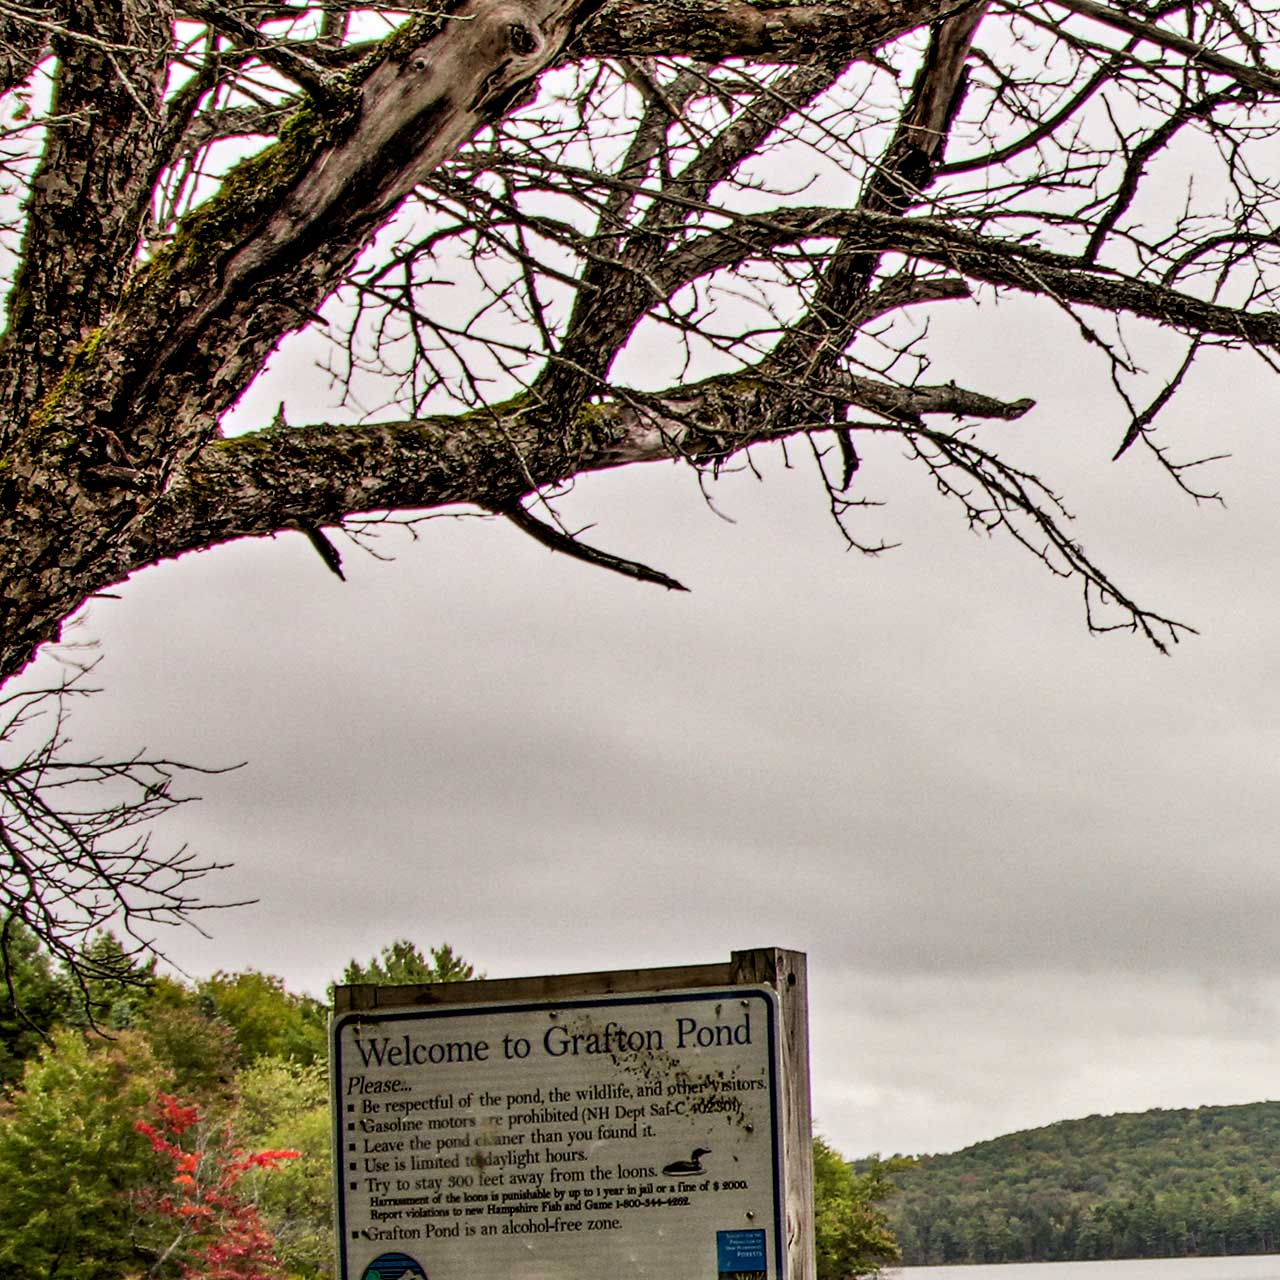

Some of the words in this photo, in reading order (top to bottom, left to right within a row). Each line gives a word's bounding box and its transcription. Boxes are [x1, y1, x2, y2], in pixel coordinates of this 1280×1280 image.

[354, 1035, 489, 1068] Welcome
[502, 1033, 531, 1060] to
[543, 1022, 664, 1057] Grafton
[675, 1013, 753, 1049] Pond
[346, 1075, 413, 1096] Please...
[362, 1099, 380, 1115] Be
[385, 1095, 454, 1116] respectful
[458, 1092, 475, 1108] of
[479, 1091, 501, 1107] the
[506, 1088, 545, 1110] pond,
[549, 1087, 571, 1102] the
[576, 1082, 634, 1101] wildlife,
[637, 1080, 663, 1098] and
[667, 1078, 706, 1096] other
[711, 1078, 768, 1093] visitors.
[363, 1117, 424, 1134] Gasoline
[428, 1116, 477, 1131] motors
[508, 1105, 579, 1129] prohibited
[582, 1107, 610, 1124] (NH
[615, 1103, 646, 1122] Dept
[650, 1100, 686, 1117] Saf-C
[364, 1136, 405, 1154] Leave
[410, 1134, 432, 1151] the
[436, 1132, 471, 1154] pond
[531, 1128, 563, 1144] than
[567, 1131, 593, 1147] you
[597, 1124, 638, 1140] found
[643, 1123, 657, 1138] it.
[364, 1157, 390, 1174] Use
[394, 1155, 406, 1172] is
[410, 1152, 460, 1171] limited
[485, 1147, 541, 1170] daylight
[545, 1148, 588, 1165] hours.
[365, 1178, 390, 1197] Try
[396, 1177, 410, 1191] to
[415, 1175, 443, 1195] stay
[447, 1174, 474, 1189] 300
[478, 1170, 505, 1187] feet
[509, 1172, 545, 1190] away
[549, 1167, 585, 1184] from
[590, 1165, 613, 1181] the
[617, 1163, 659, 1180] loons.
[432, 1193, 443, 1204] of
[446, 1192, 461, 1204] the
[464, 1191, 489, 1203] loons
[491, 1190, 499, 1201] is
[502, 1187, 551, 1204] punishable
[554, 1187, 566, 1200] by
[568, 1188, 581, 1201] up
[584, 1187, 594, 1197] to
[603, 1187, 624, 1199] year
[627, 1184, 637, 1195] in
[639, 1183, 653, 1197] jail
[656, 1184, 667, 1194] or
[669, 1184, 676, 1193] a
[678, 1181, 697, 1193] fine
[699, 1180, 711, 1192] of
[713, 1180, 719, 1192] $
[370, 1209, 402, 1223] Report
[406, 1207, 450, 1219] violations
[452, 1207, 463, 1218] to
[465, 1207, 484, 1216] new
[487, 1203, 539, 1217] Hampshire
[541, 1201, 562, 1213] Fish
[564, 1201, 582, 1211] and
[584, 1200, 613, 1210] Game
[367, 1226, 422, 1242] Grafton
[425, 1222, 460, 1239] Pond
[465, 1223, 476, 1237] is
[480, 1224, 498, 1236] an
[502, 1216, 583, 1235] alcohol-free
[587, 1218, 623, 1231] zone.
